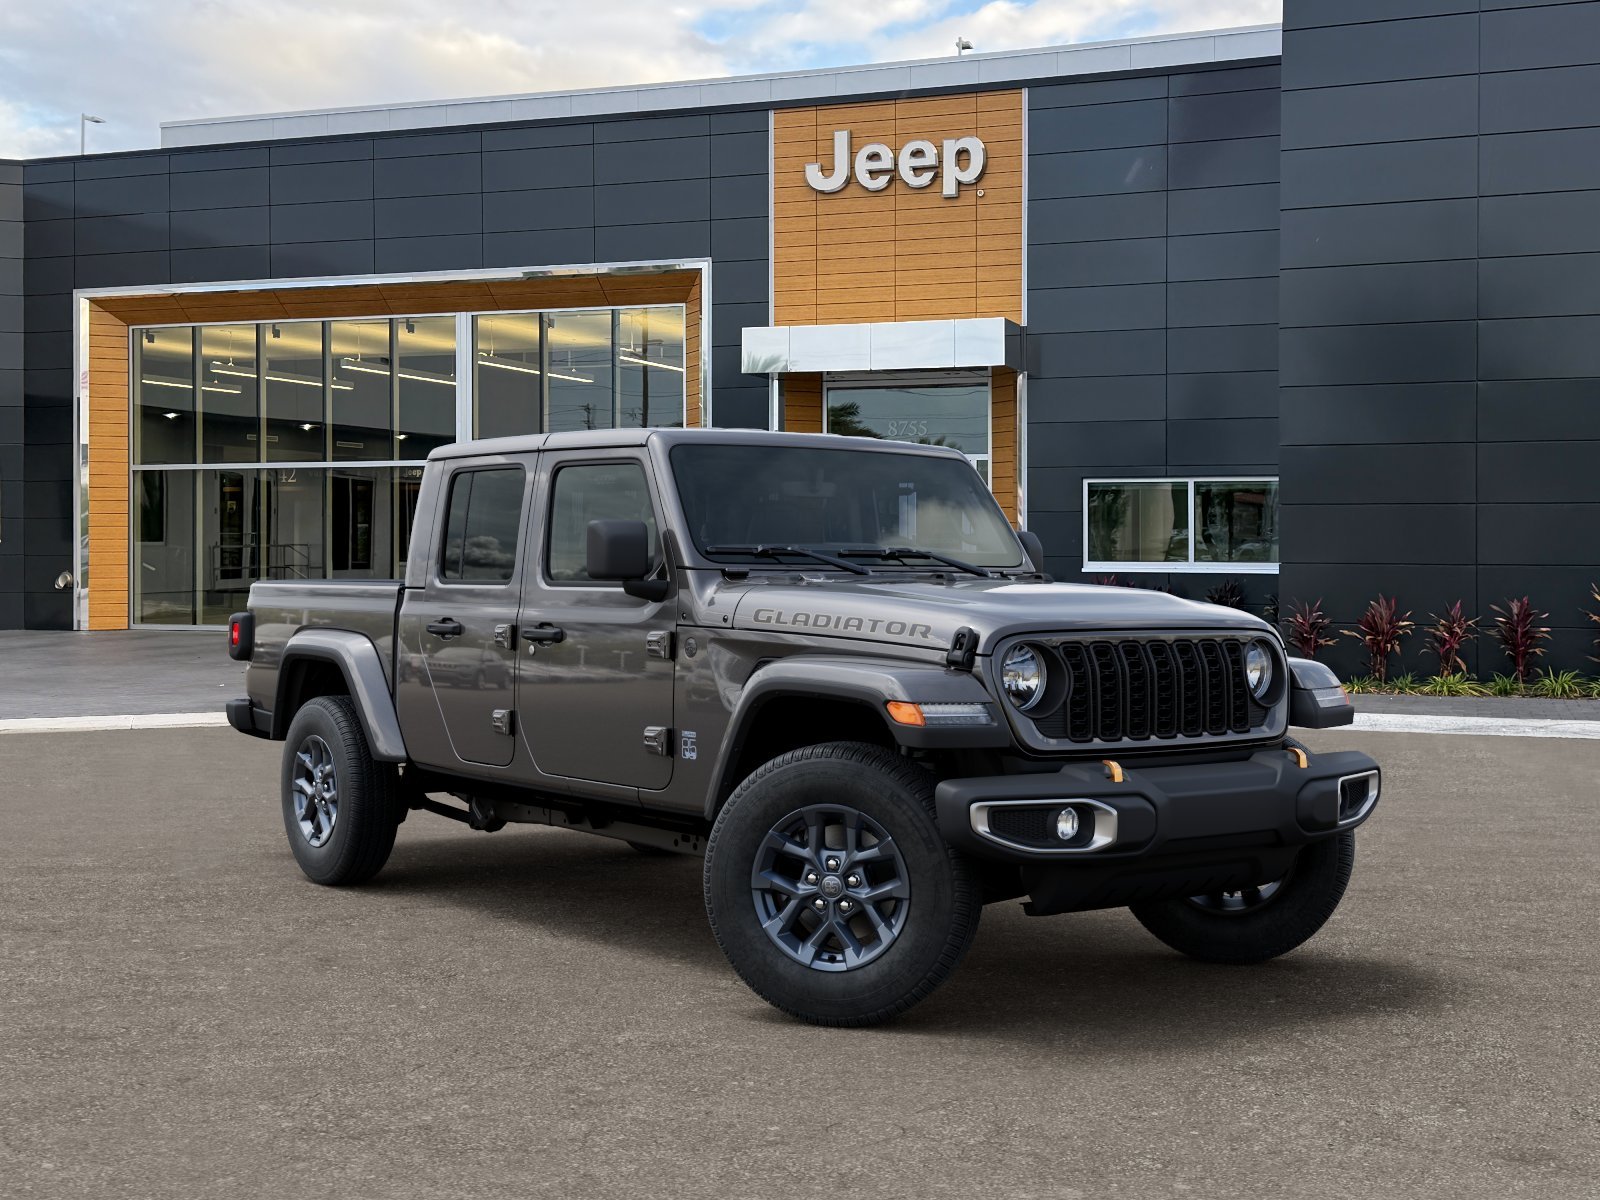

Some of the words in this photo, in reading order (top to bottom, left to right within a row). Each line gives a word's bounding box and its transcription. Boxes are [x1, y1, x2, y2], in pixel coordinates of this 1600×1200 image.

[804, 129, 987, 198] Jeep
[887, 420, 928, 437] 8755
[753, 608, 932, 639] GLADIATOR
